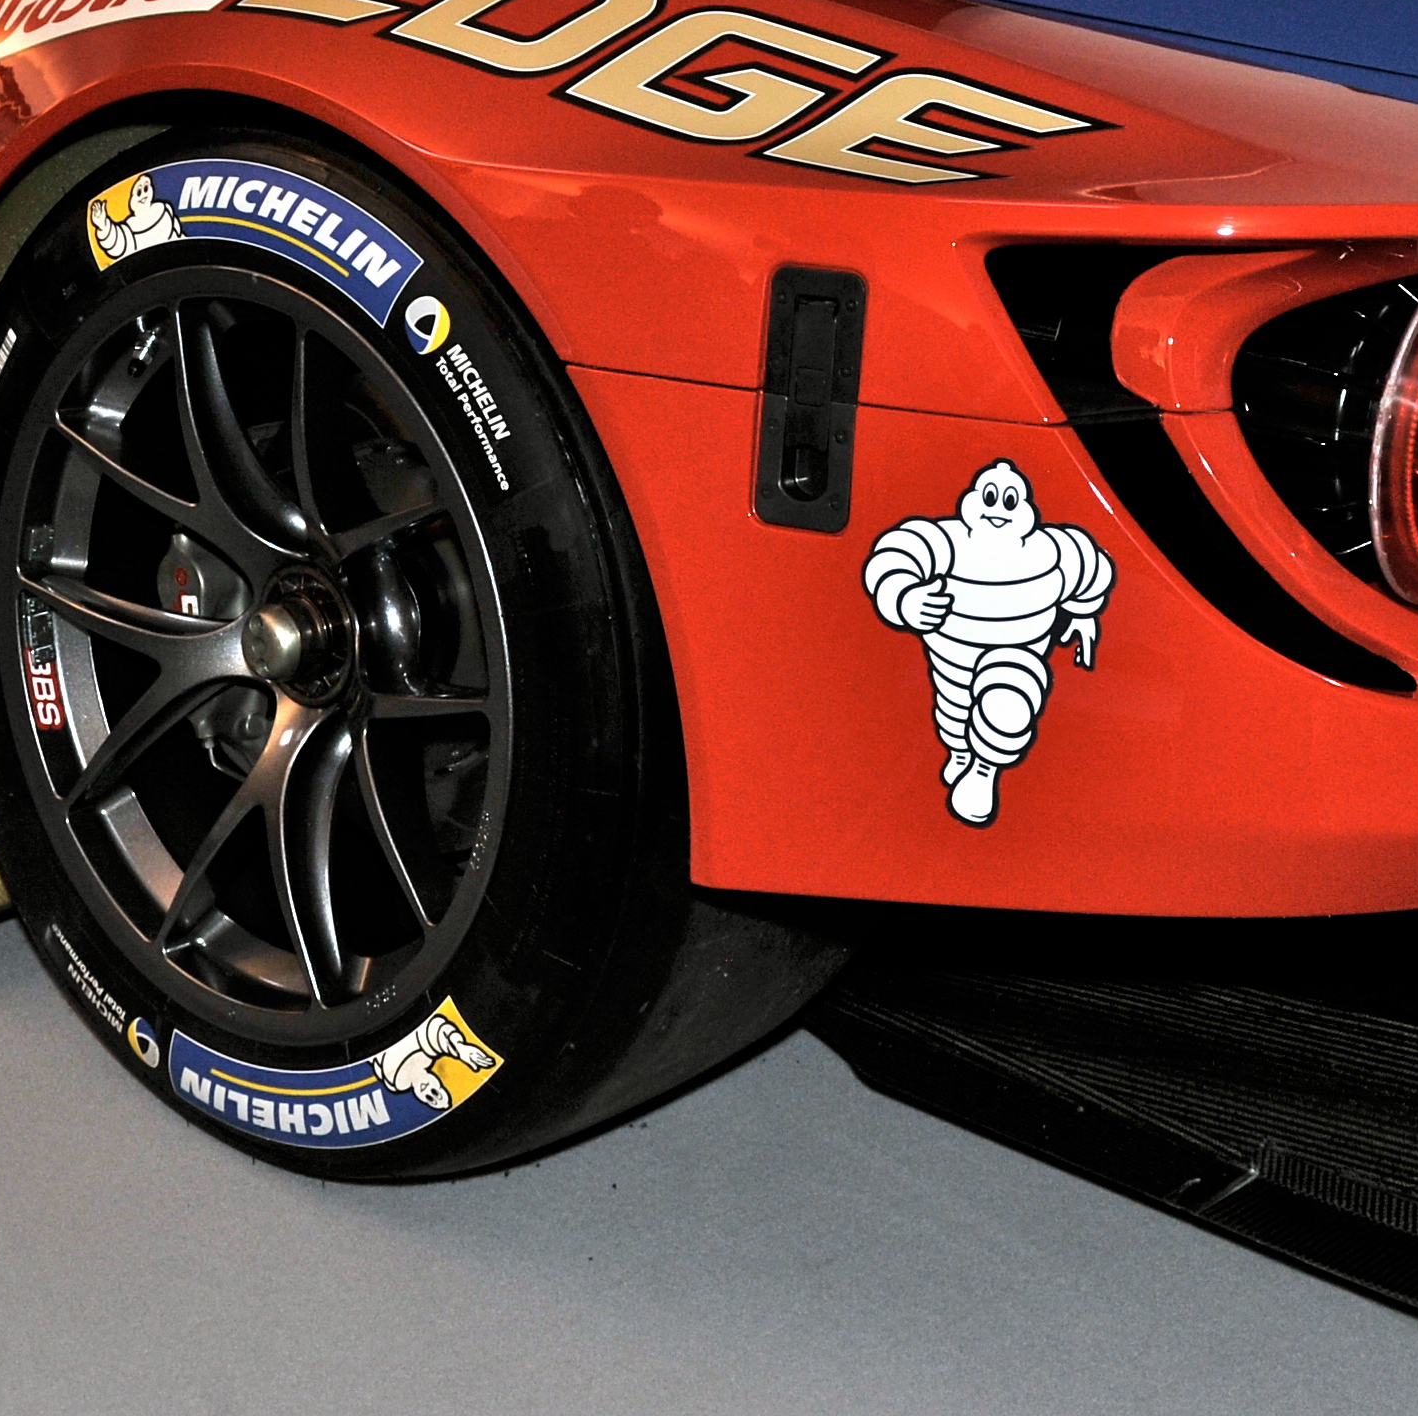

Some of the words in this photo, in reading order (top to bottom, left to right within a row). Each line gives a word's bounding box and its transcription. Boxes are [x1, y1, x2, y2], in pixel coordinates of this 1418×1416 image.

[178, 176, 401, 288] MICHELIN
[435, 356, 463, 393] Total
[457, 392, 510, 491] Performance
[446, 343, 511, 441] MICHELIN
[51, 923, 104, 996] Performance
[68, 962, 123, 1034] MICHELIN
[103, 992, 127, 1022] Total
[180, 1066, 391, 1137] MICHELIN
